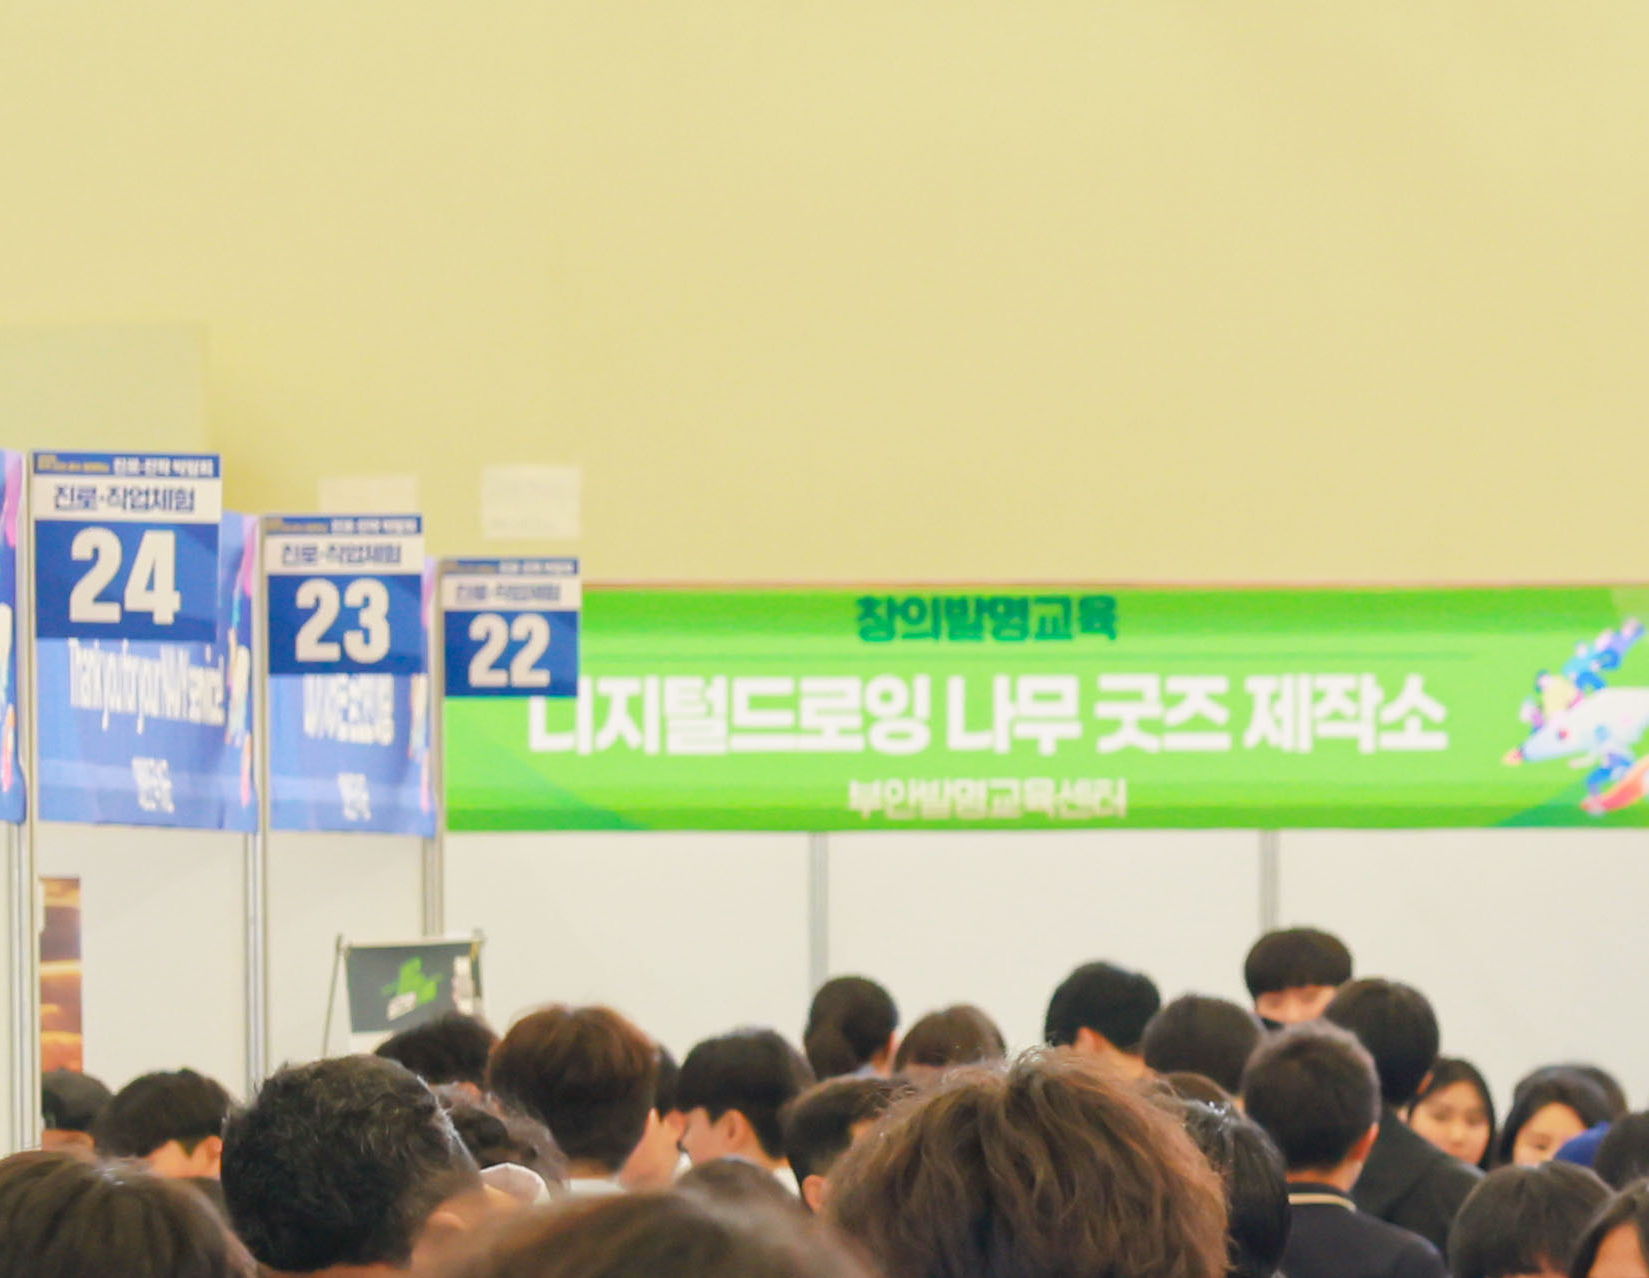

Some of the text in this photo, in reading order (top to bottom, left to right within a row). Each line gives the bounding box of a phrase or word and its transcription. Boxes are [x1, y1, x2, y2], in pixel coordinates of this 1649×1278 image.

[54, 485, 196, 513] 진로·직업체험
[69, 526, 182, 625] 24
[294, 577, 391, 665] 23
[467, 612, 552, 689] 22
[855, 593, 1118, 644] 창의발명교육
[946, 672, 1084, 755] 나무
[1094, 672, 1233, 753] 굿즈
[1243, 672, 1449, 755] 제작소
